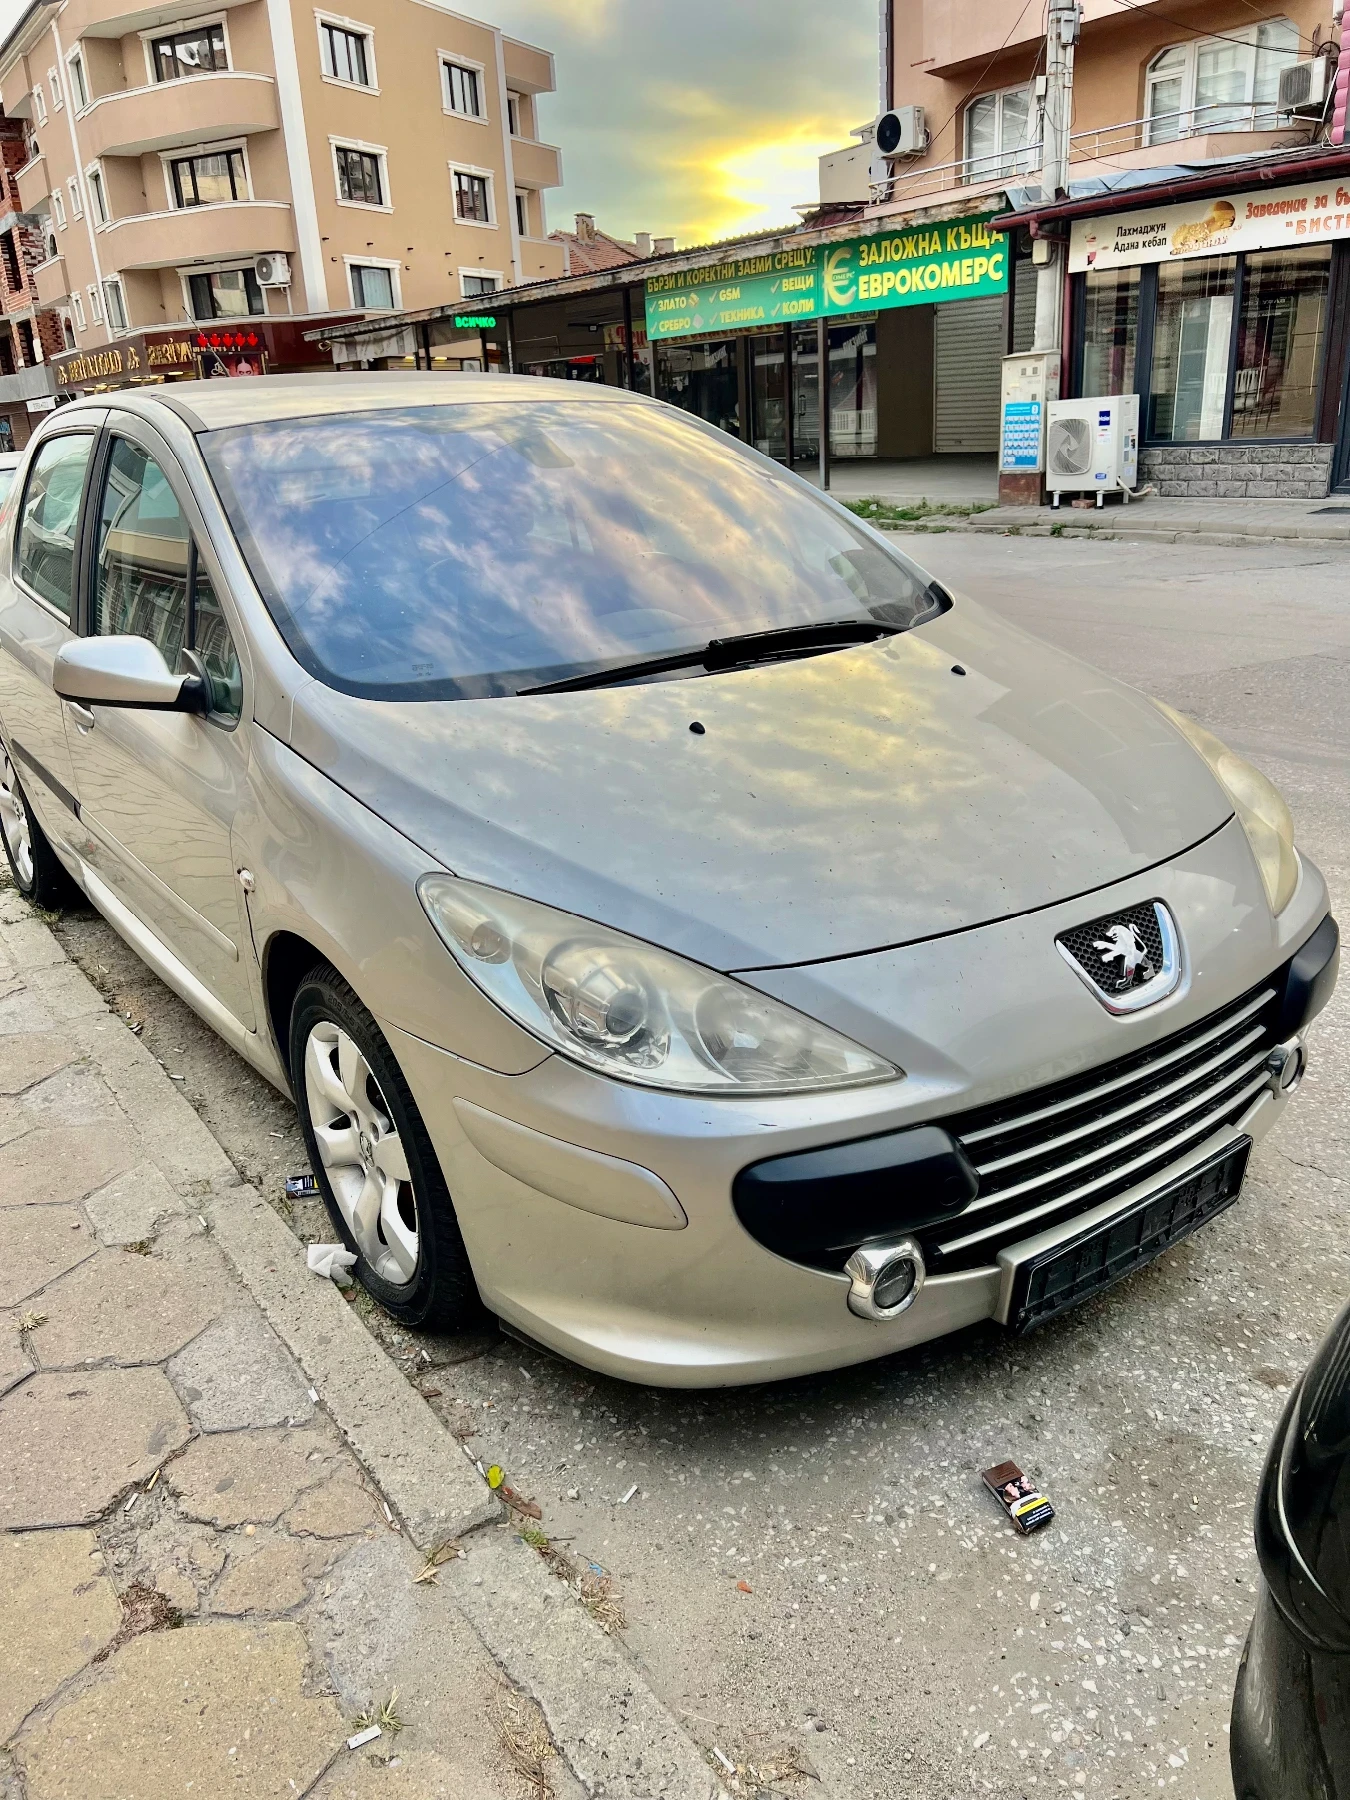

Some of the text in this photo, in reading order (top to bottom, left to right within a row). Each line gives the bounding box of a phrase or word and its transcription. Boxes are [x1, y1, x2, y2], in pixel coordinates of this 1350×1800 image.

[1246, 198, 1308, 219] Заведение
[1313, 195, 1329, 209] за
[1116, 222, 1167, 238] Лахмаджун
[859, 230, 942, 267] ЗАЛОЖНА
[1113, 240, 1140, 253] Адана
[1142, 236, 1167, 248] кебап
[647, 248, 816, 293] БЪРЗИ И КОРЕКТНИ ЗАЕМИ СРЕЩУ:
[858, 253, 1004, 300] ЕВРОКОМЕРС
[782, 275, 814, 292] ВЕЩИ
[719, 287, 741, 302] GSM
[658, 296, 687, 311] ЗЛАТО
[782, 298, 814, 316] КОЛИ
[455, 316, 496, 328] ВСИЧКО
[720, 306, 765, 324] ТЕХНИКА
[659, 317, 691, 332] СРЕБРО
